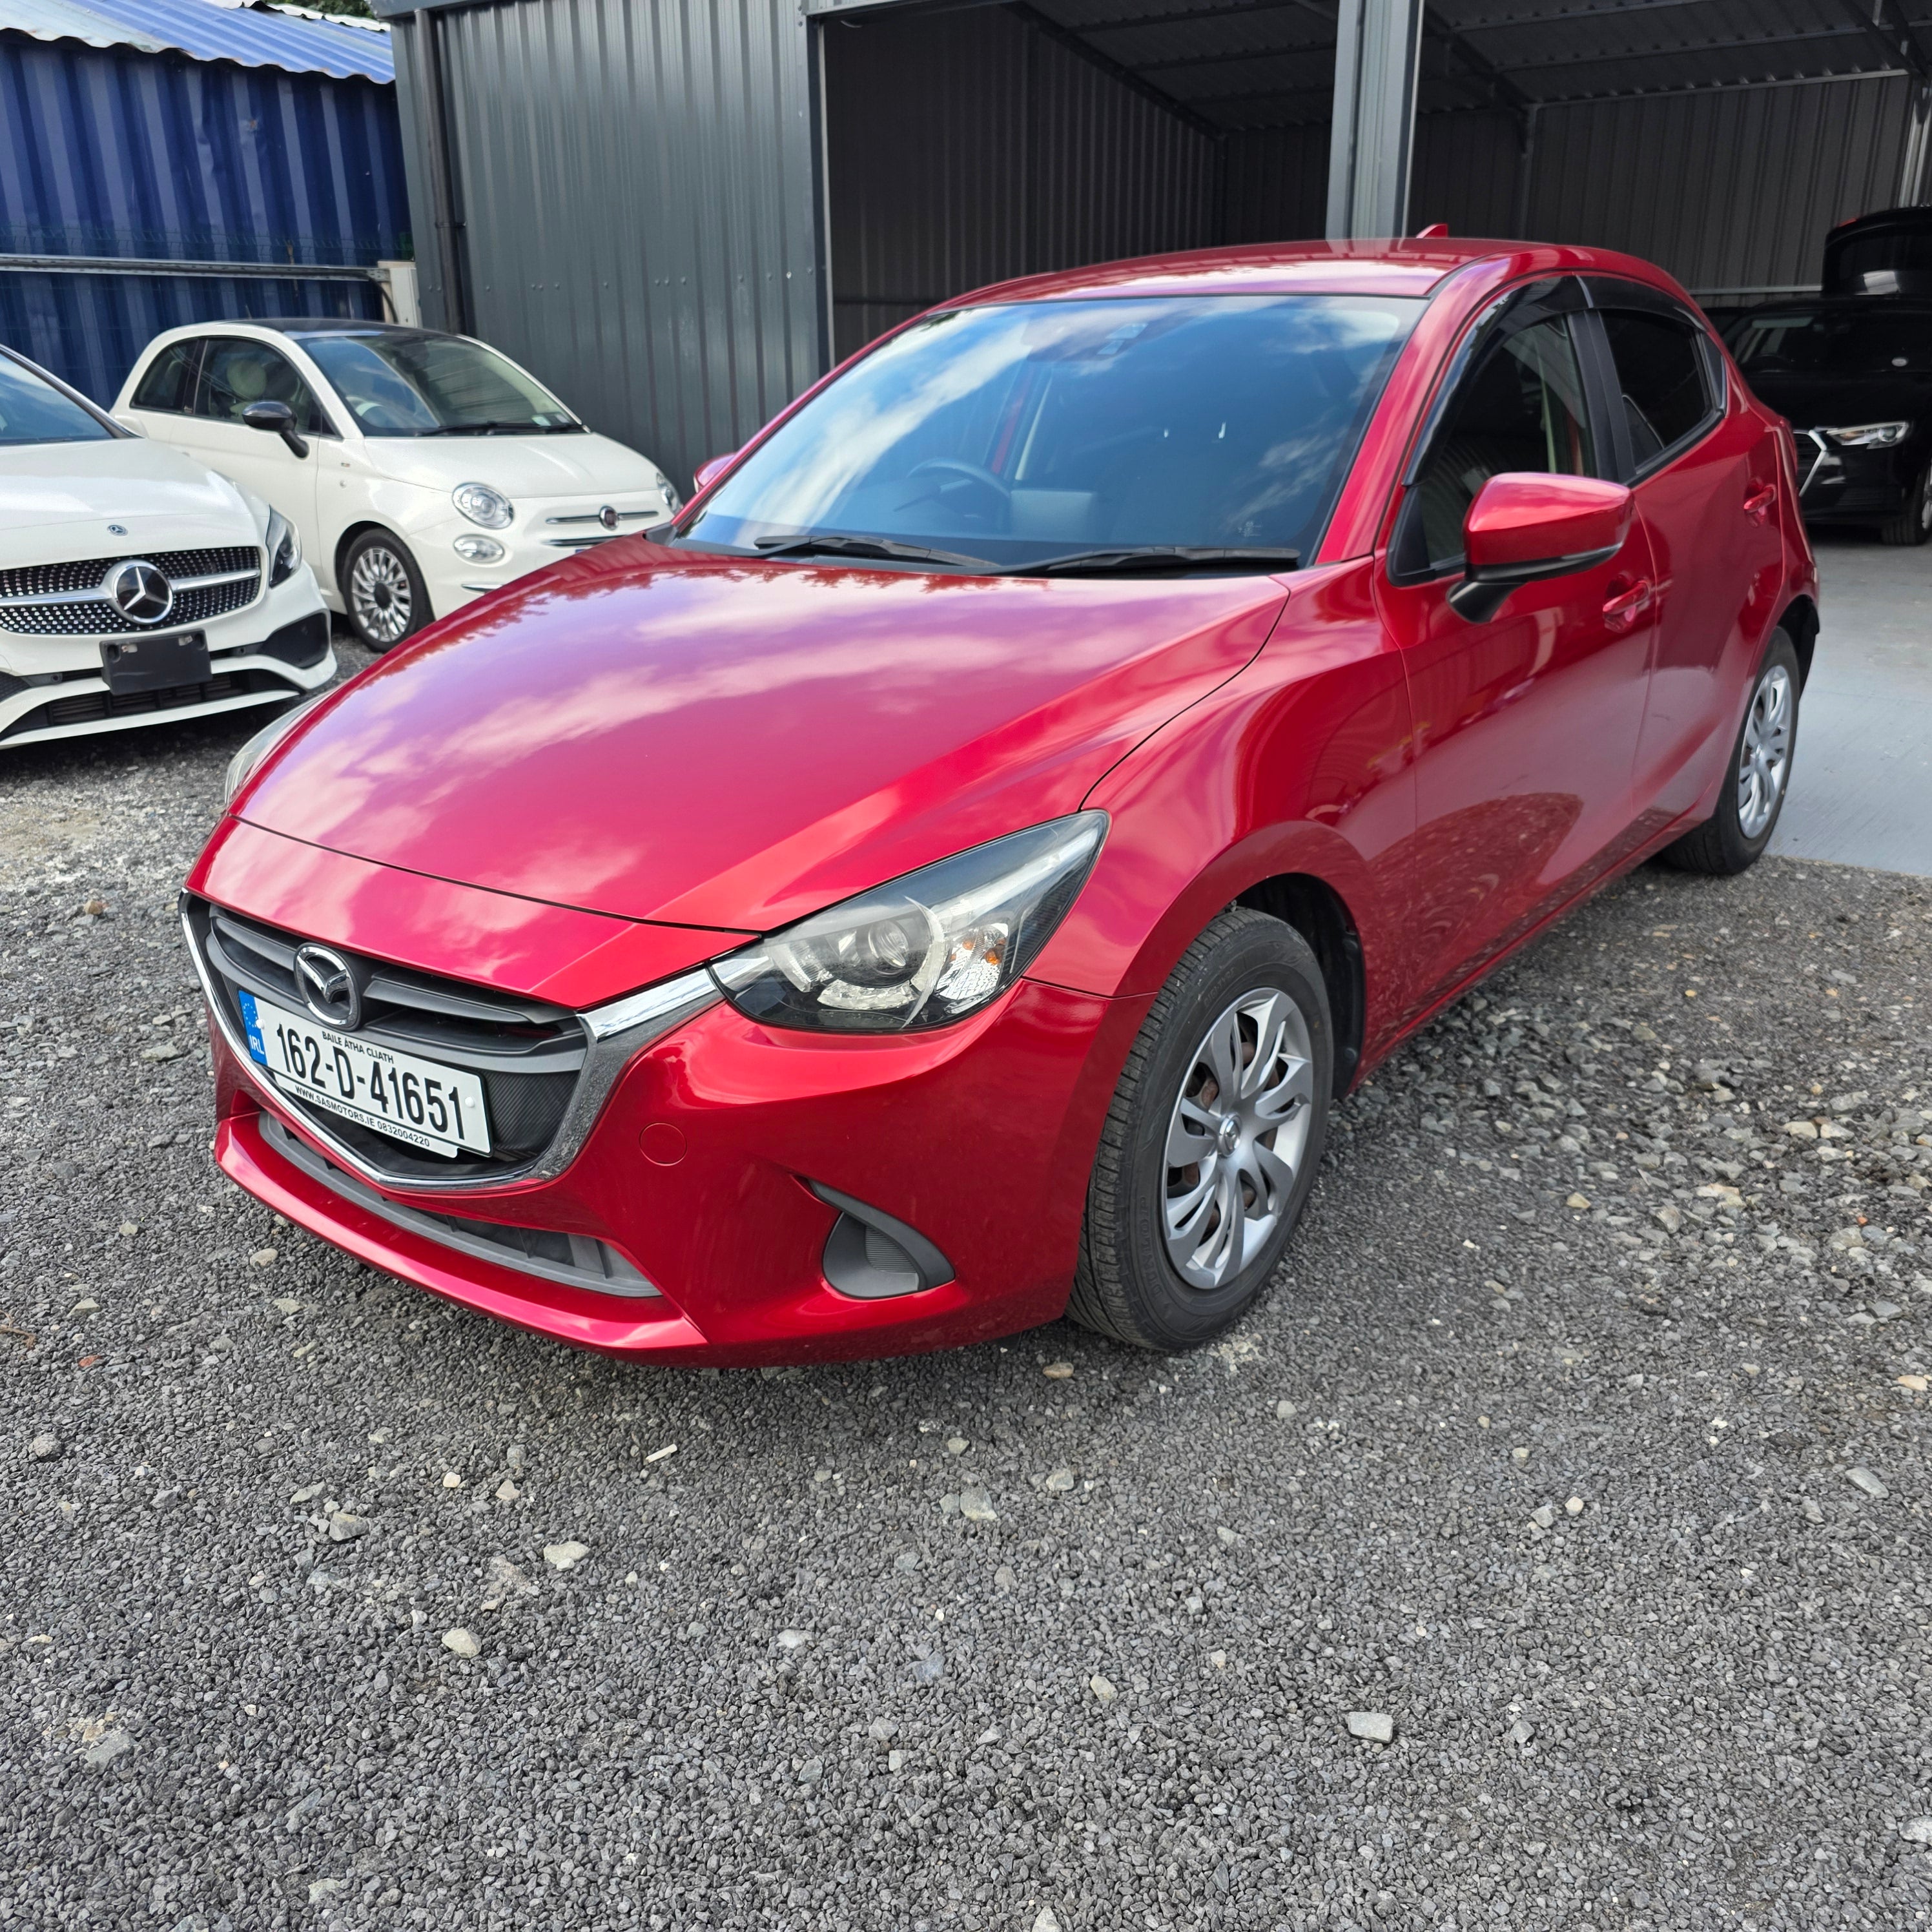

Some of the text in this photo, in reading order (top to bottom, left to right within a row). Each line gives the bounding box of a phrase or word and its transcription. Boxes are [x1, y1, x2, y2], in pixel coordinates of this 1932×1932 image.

[249, 1034, 265, 1055] IRL
[322, 1031, 343, 1046] BAILE
[366, 1047, 395, 1064] CLIATH
[276, 1023, 466, 1140] 162-D-41651
[294, 1085, 431, 1147] WWW.SASMOTORS.IE 0832004220
[1140, 1196, 1163, 1297] DUNLOP
